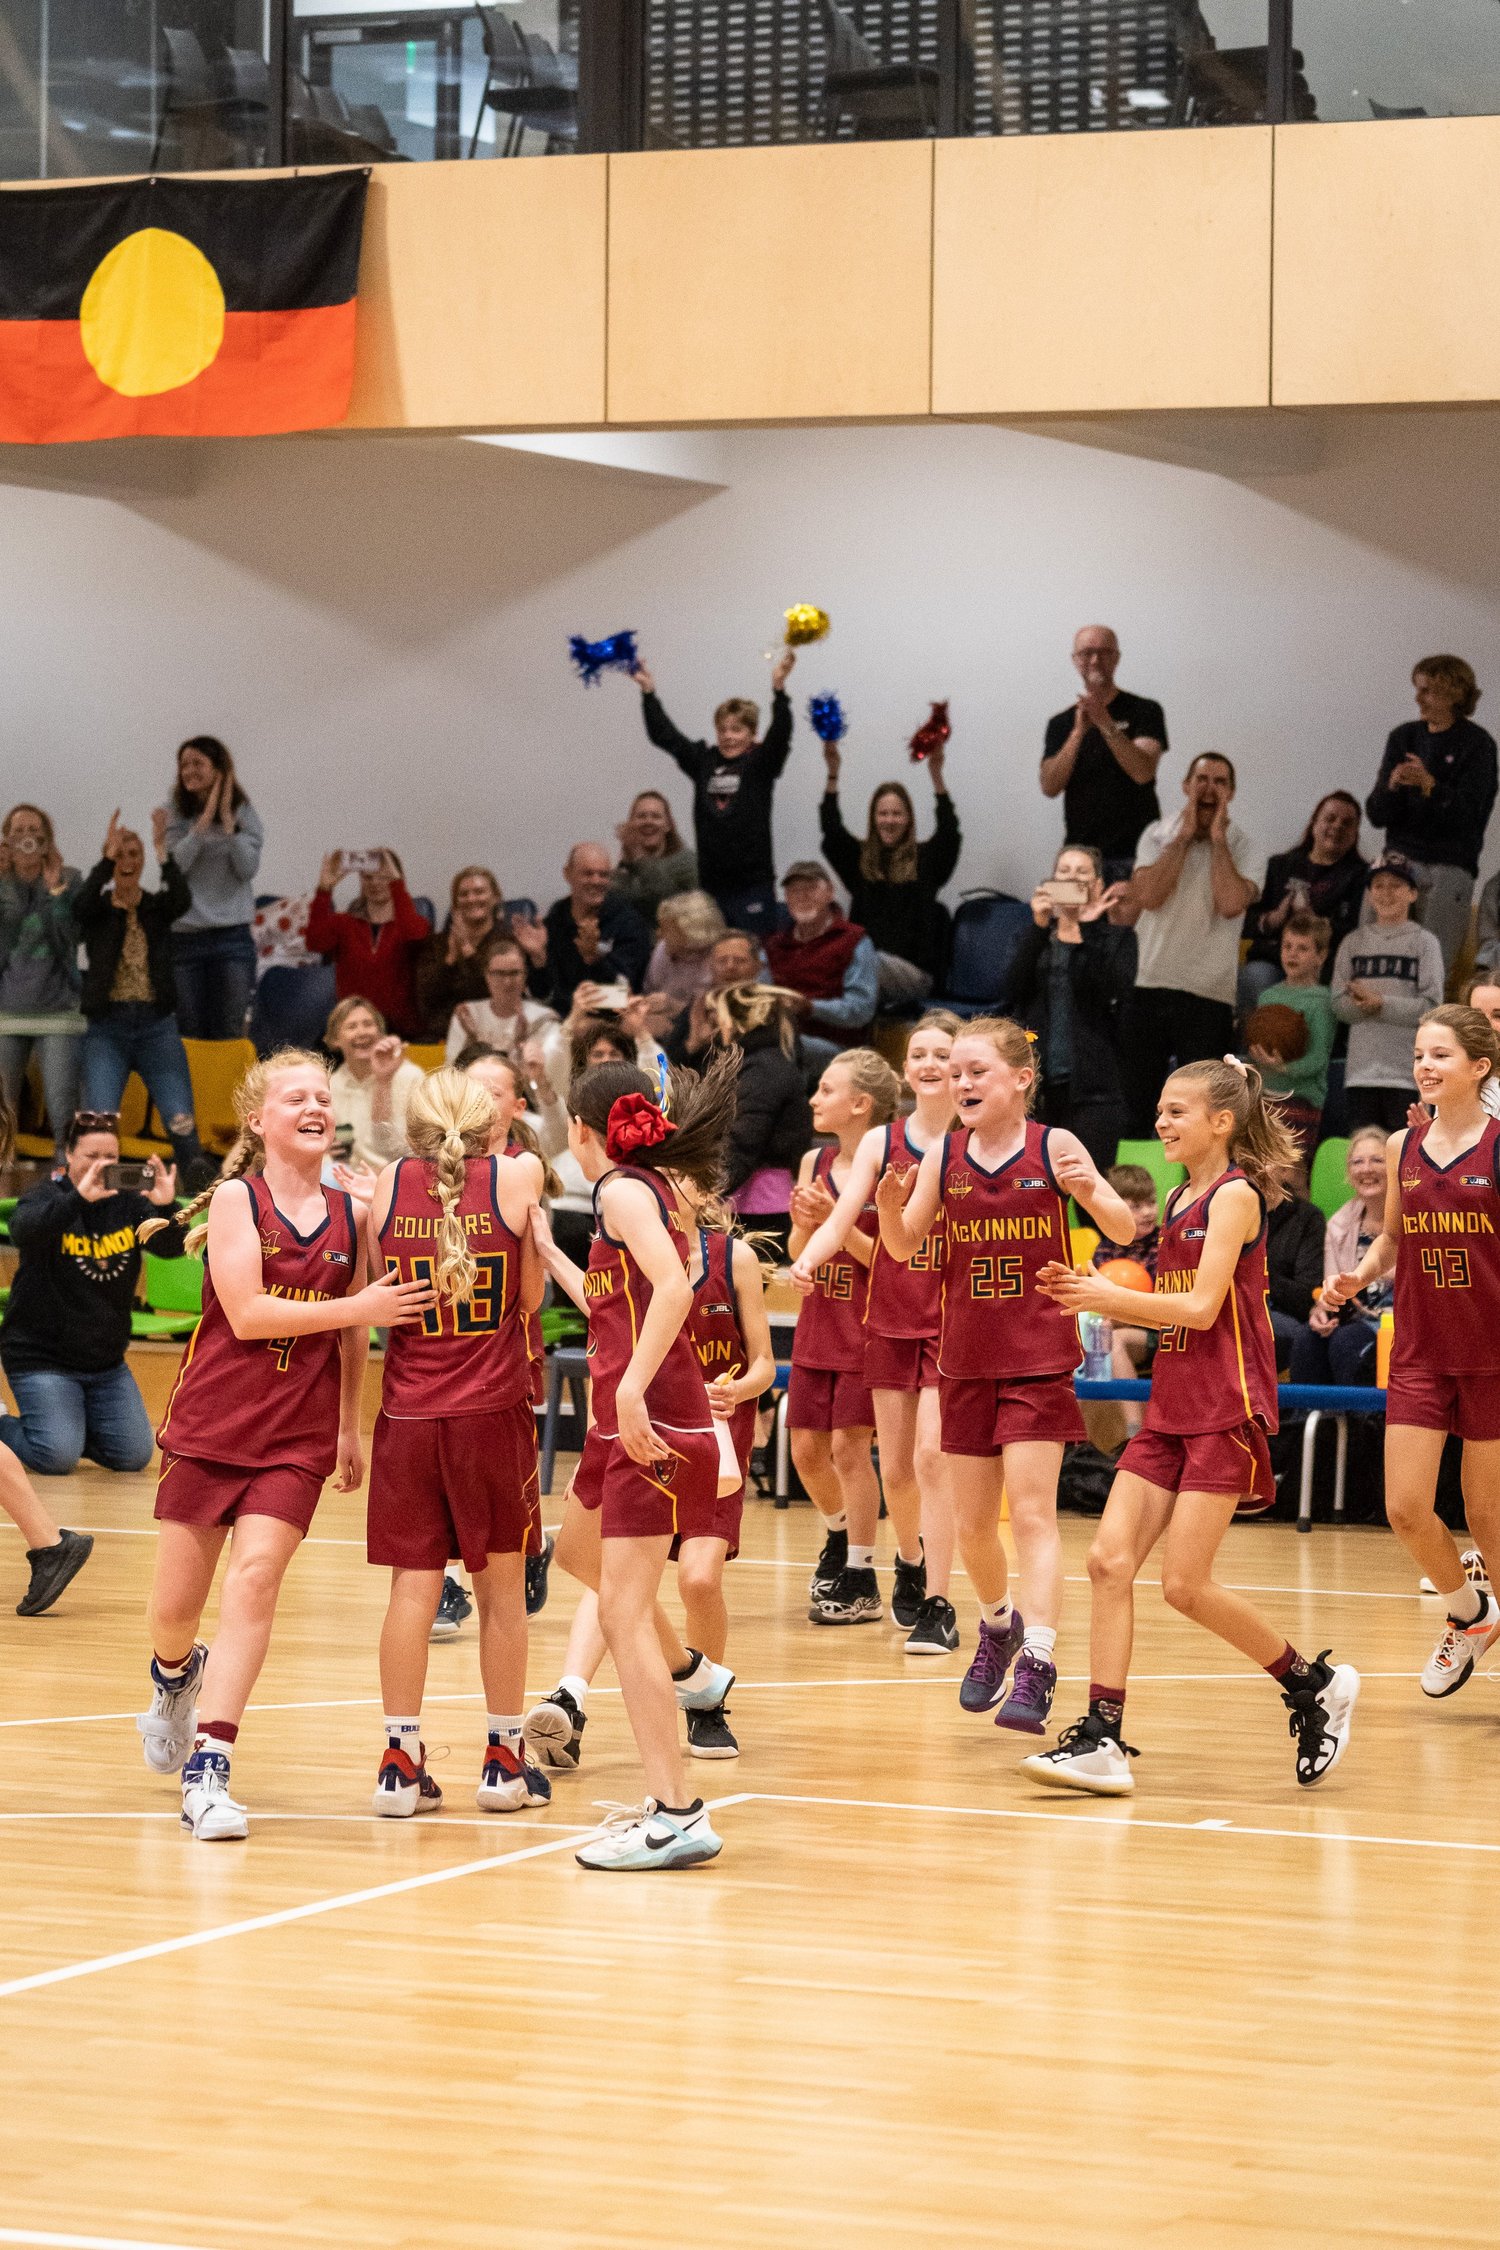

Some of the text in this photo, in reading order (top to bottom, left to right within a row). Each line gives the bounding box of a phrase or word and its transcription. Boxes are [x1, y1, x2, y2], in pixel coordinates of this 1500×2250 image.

[393, 1213, 493, 1239] COUGRS
[814, 1263, 853, 1301] 45
[970, 1256, 1024, 1299] 25
[1421, 1248, 1472, 1288] 43
